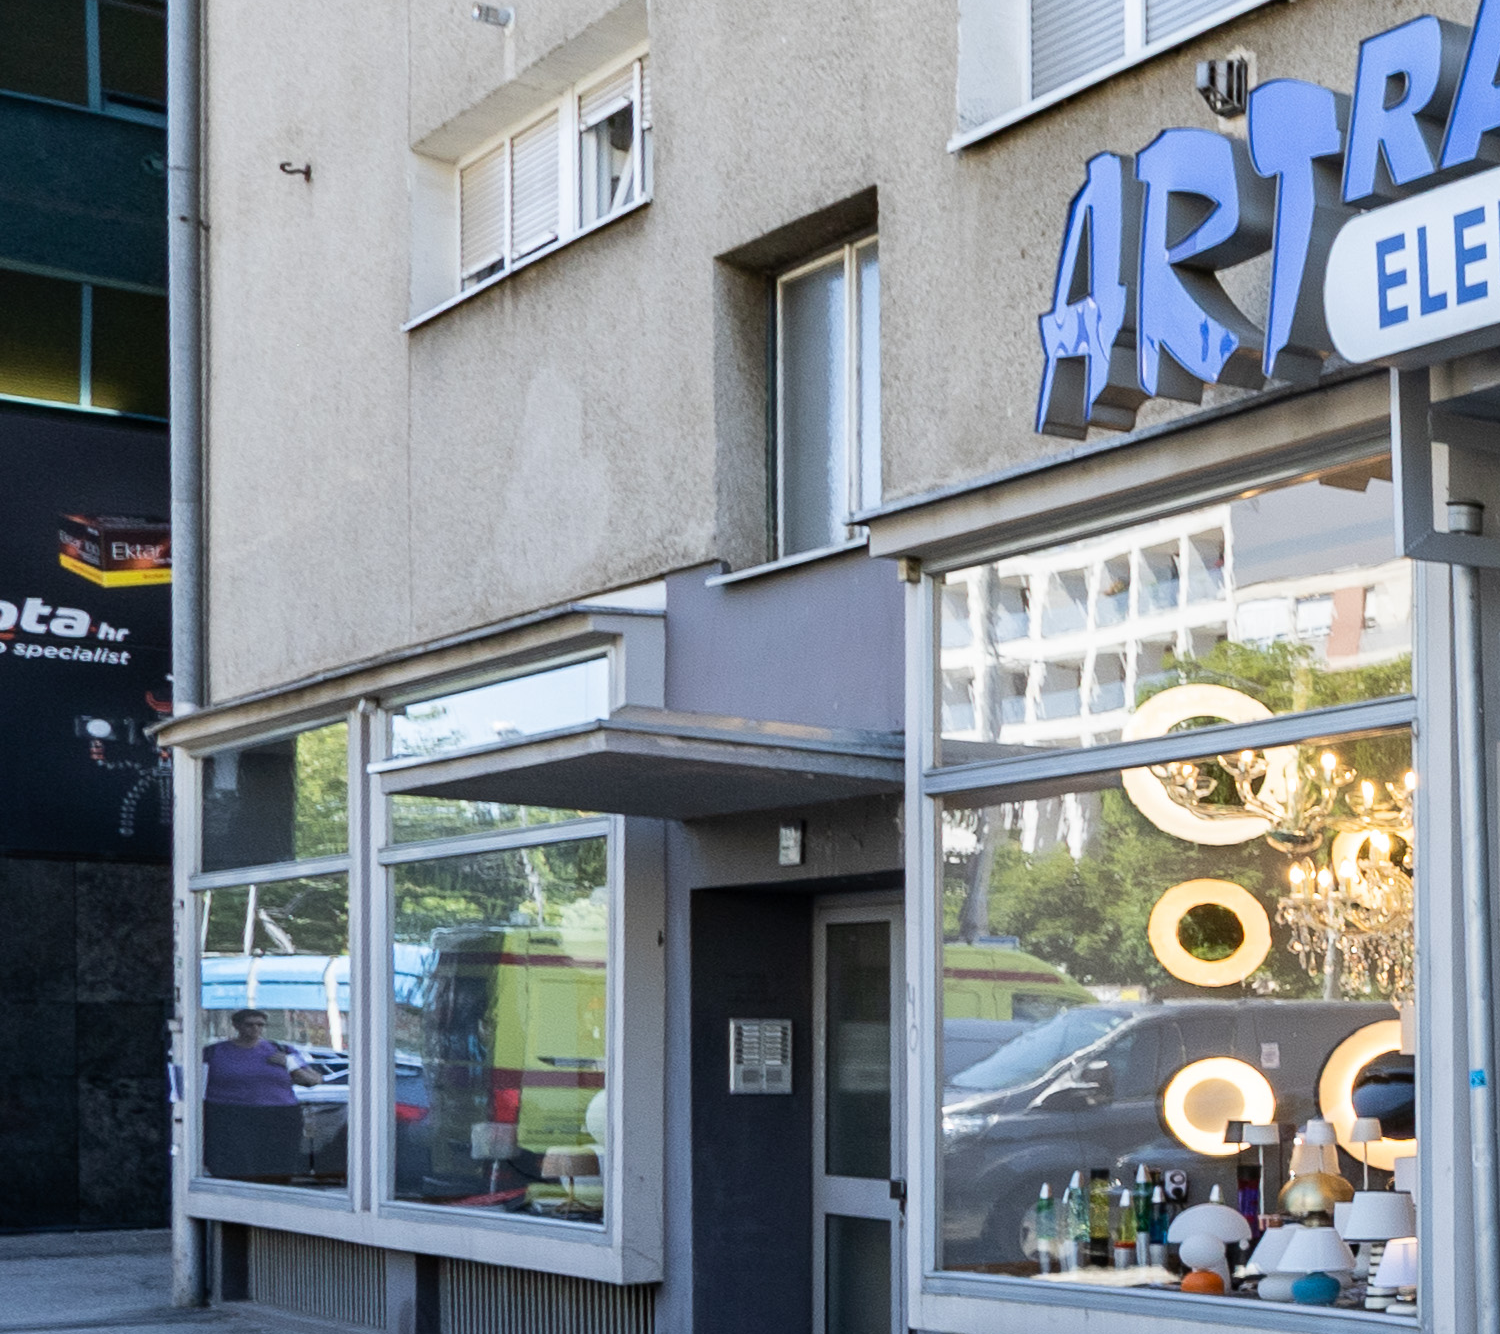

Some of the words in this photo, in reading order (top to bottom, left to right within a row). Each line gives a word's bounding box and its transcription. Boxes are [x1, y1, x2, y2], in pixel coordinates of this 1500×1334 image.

[1036, 77, 1345, 437] ART
[110, 540, 165, 562] Ektar
[12, 642, 132, 666] specialist
